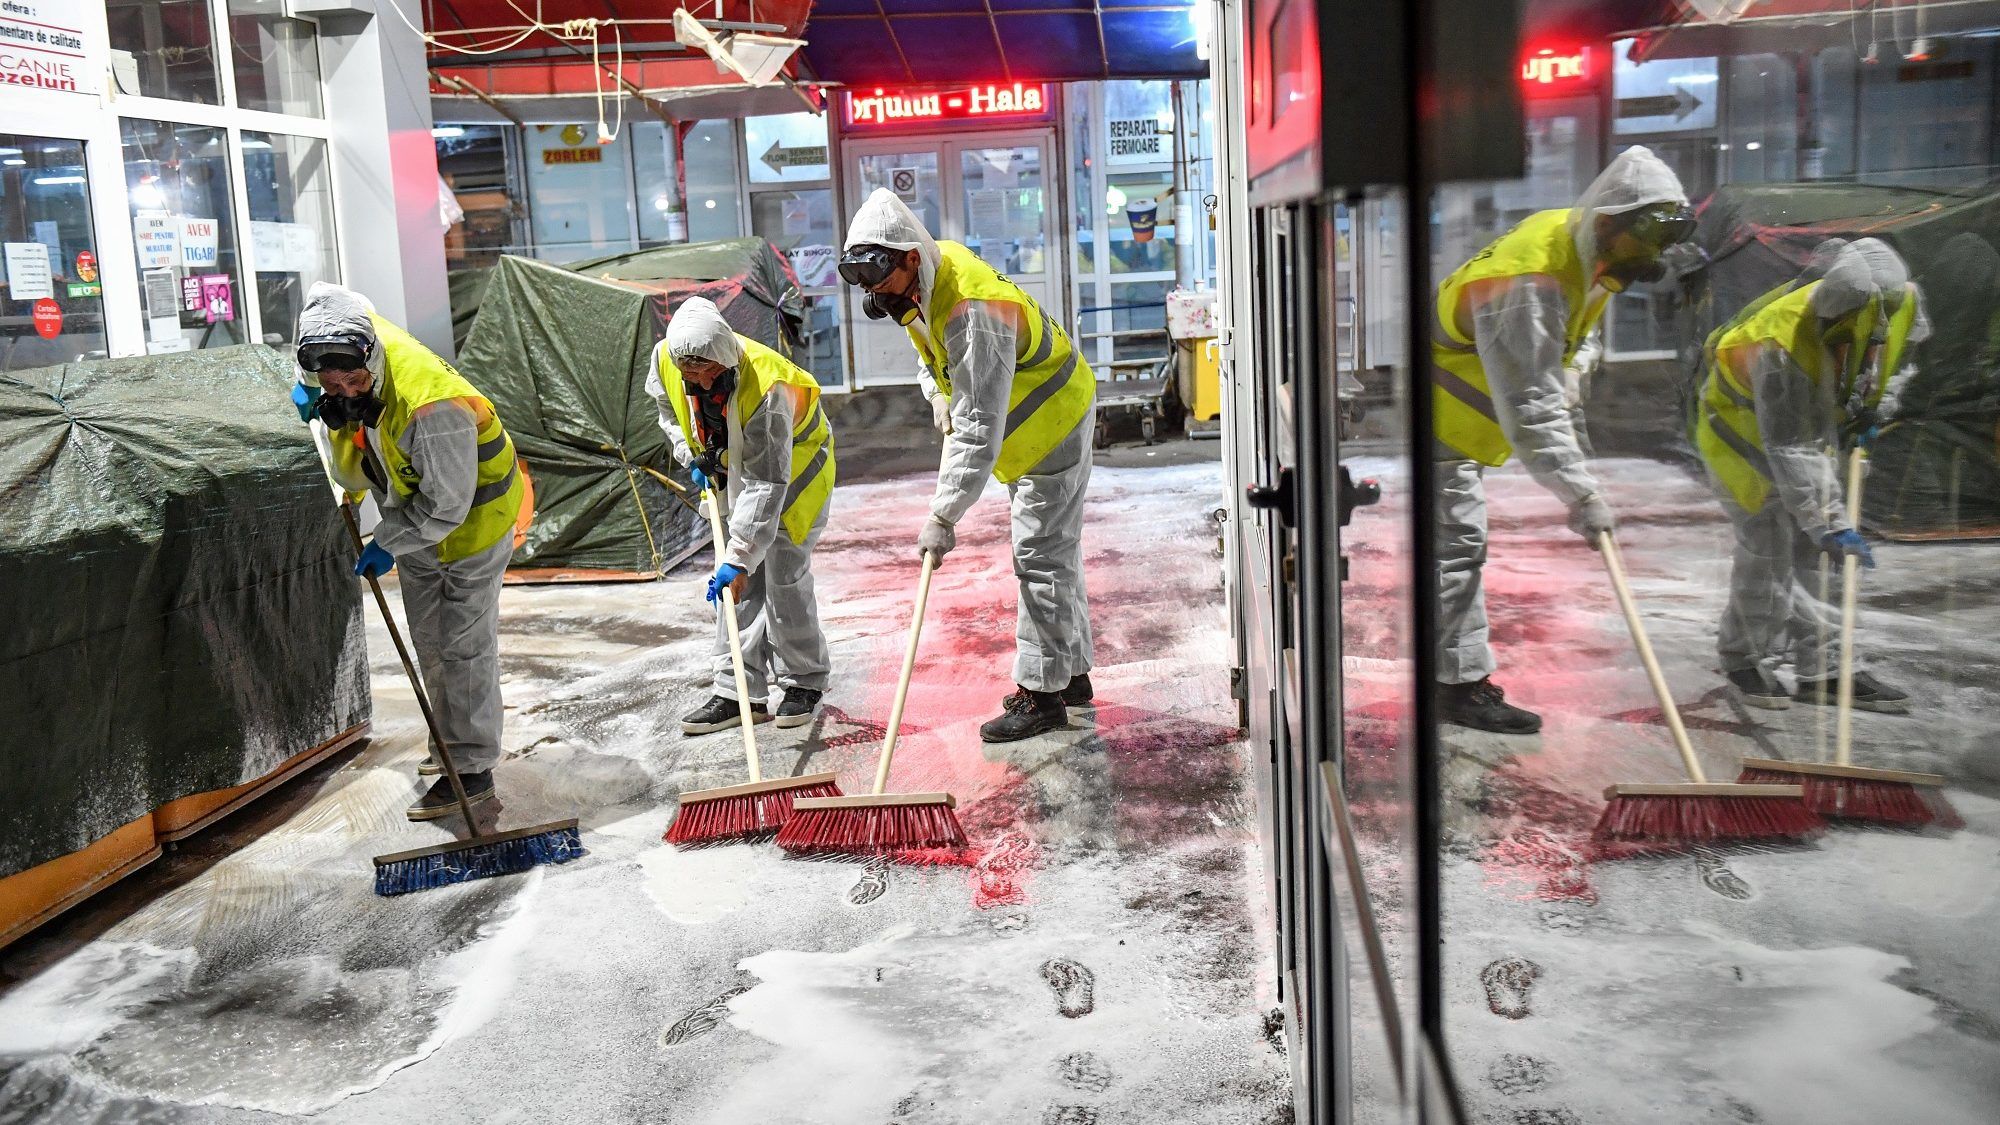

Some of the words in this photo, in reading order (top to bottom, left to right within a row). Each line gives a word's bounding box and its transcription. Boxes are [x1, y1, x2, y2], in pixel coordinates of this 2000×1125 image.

[2, 1, 30, 15] ofera
[37, 29, 47, 43] de
[50, 33, 81, 49] calitate
[0, 55, 71, 78] CANIE
[969, 83, 1042, 113] Hala
[1111, 138, 1160, 155] FERMOARE
[767, 154, 787, 162] FLORI
[150, 219, 163, 227] AVEM
[187, 223, 211, 237] AVEM
[184, 246, 215, 261] TIGARI
[803, 248, 832, 258] BINGO
